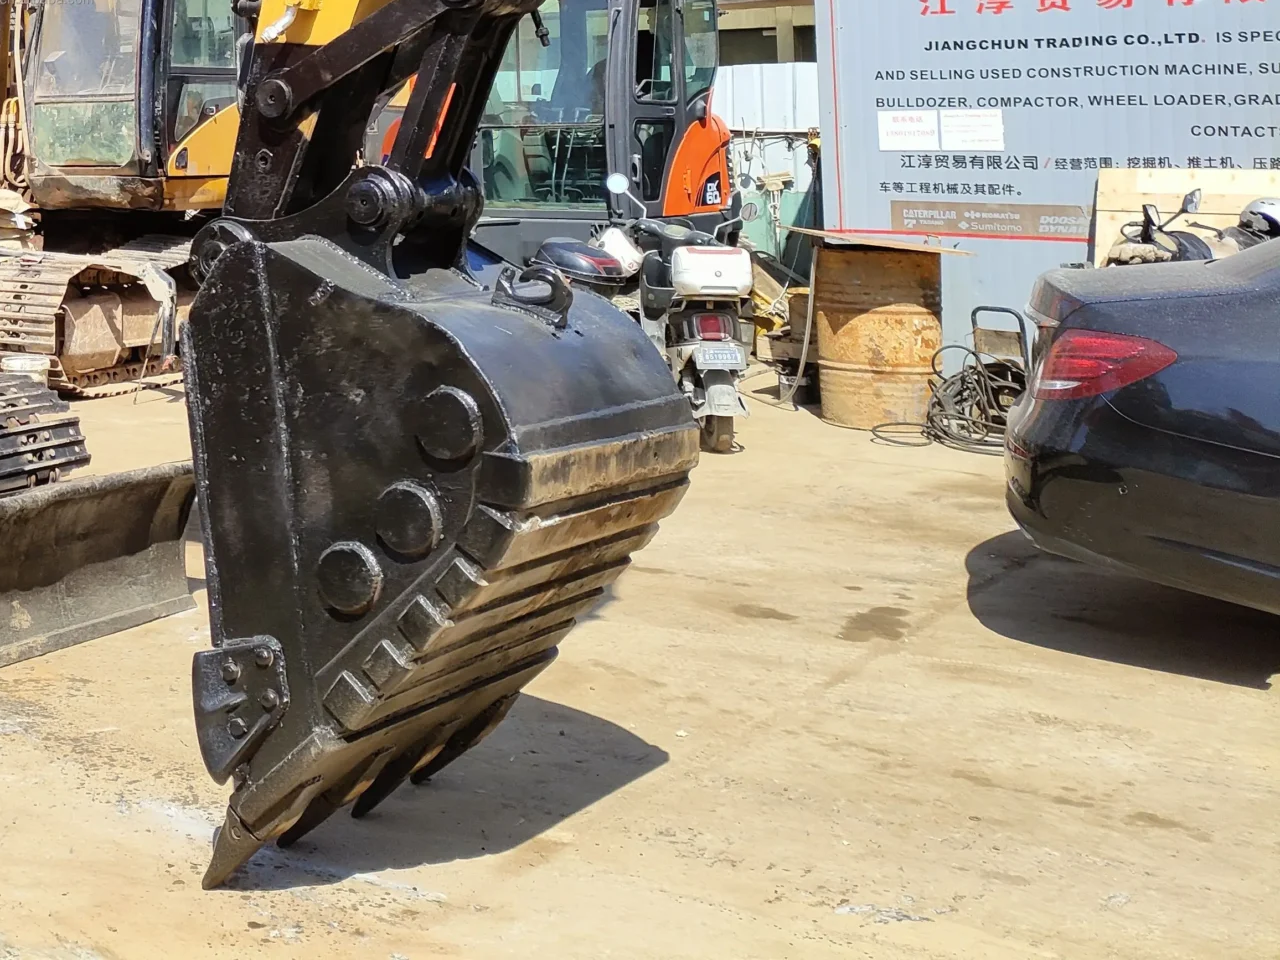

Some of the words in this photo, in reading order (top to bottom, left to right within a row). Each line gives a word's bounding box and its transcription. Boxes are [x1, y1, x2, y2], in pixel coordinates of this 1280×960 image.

[924, 38, 1029, 51] JIANGCHUN
[1034, 35, 1118, 49] TRADING
[1216, 31, 1232, 43] IS
[875, 70, 906, 81] AND
[910, 69, 975, 81] SELLING
[979, 68, 1022, 79] USED
[1026, 64, 1160, 79] CONSTRUCTION
[1164, 62, 1253, 76] MACHINE,
[876, 97, 972, 109] BULLDOZER,
[977, 95, 1084, 109] COMPACTOR,
[1088, 95, 1148, 106] WHEEL
[1191, 125, 1280, 138] CONTACT
[900, 154, 1039, 170] 江淳贸易有限公司
[903, 208, 957, 219] CATERPILLAR
[981, 211, 1021, 220] KOMATSU
[970, 222, 1023, 232] Sumitomo
